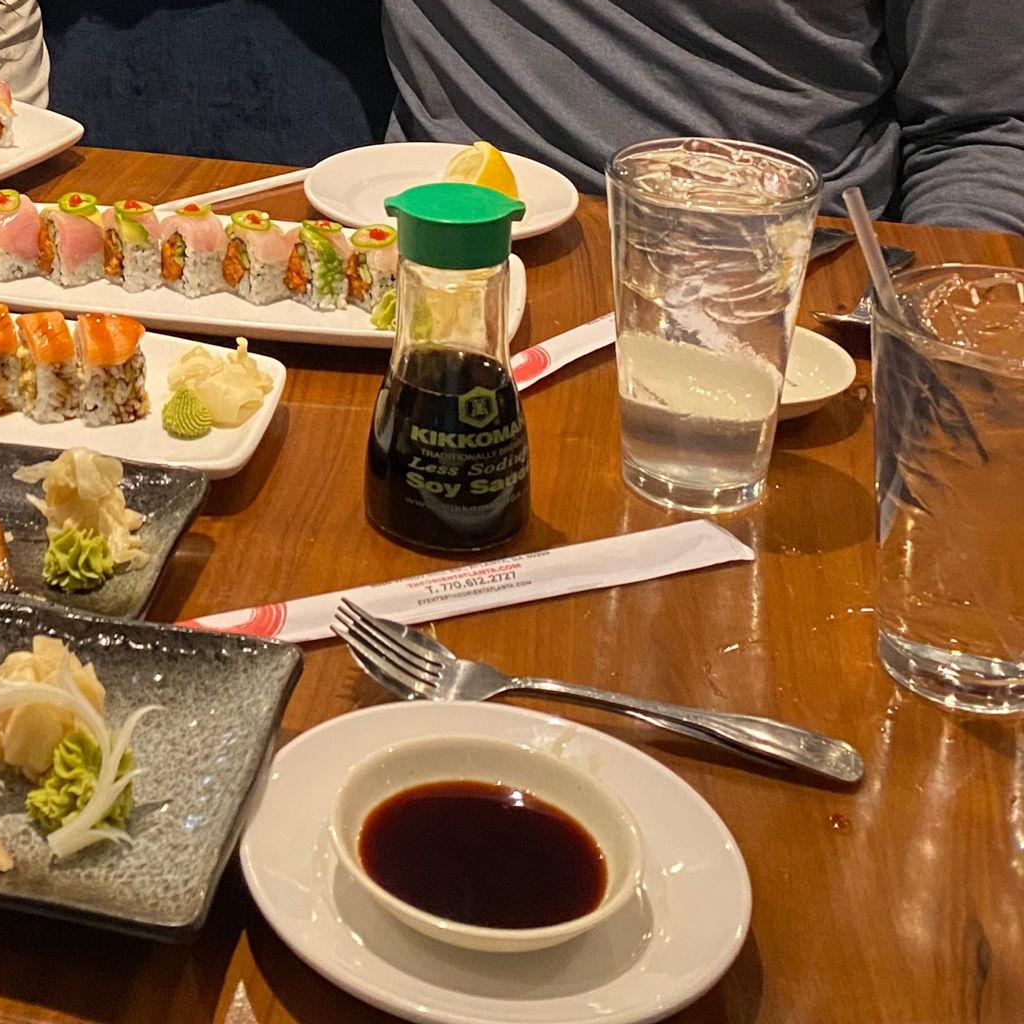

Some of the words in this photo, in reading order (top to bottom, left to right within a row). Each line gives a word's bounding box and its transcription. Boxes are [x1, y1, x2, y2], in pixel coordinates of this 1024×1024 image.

[410, 419, 524, 448] KIKKOMA
[408, 456, 459, 476] Less
[406, 472, 461, 498] Soy
[426, 585, 439, 595] T.
[440, 570, 516, 592] 770.612.2727
